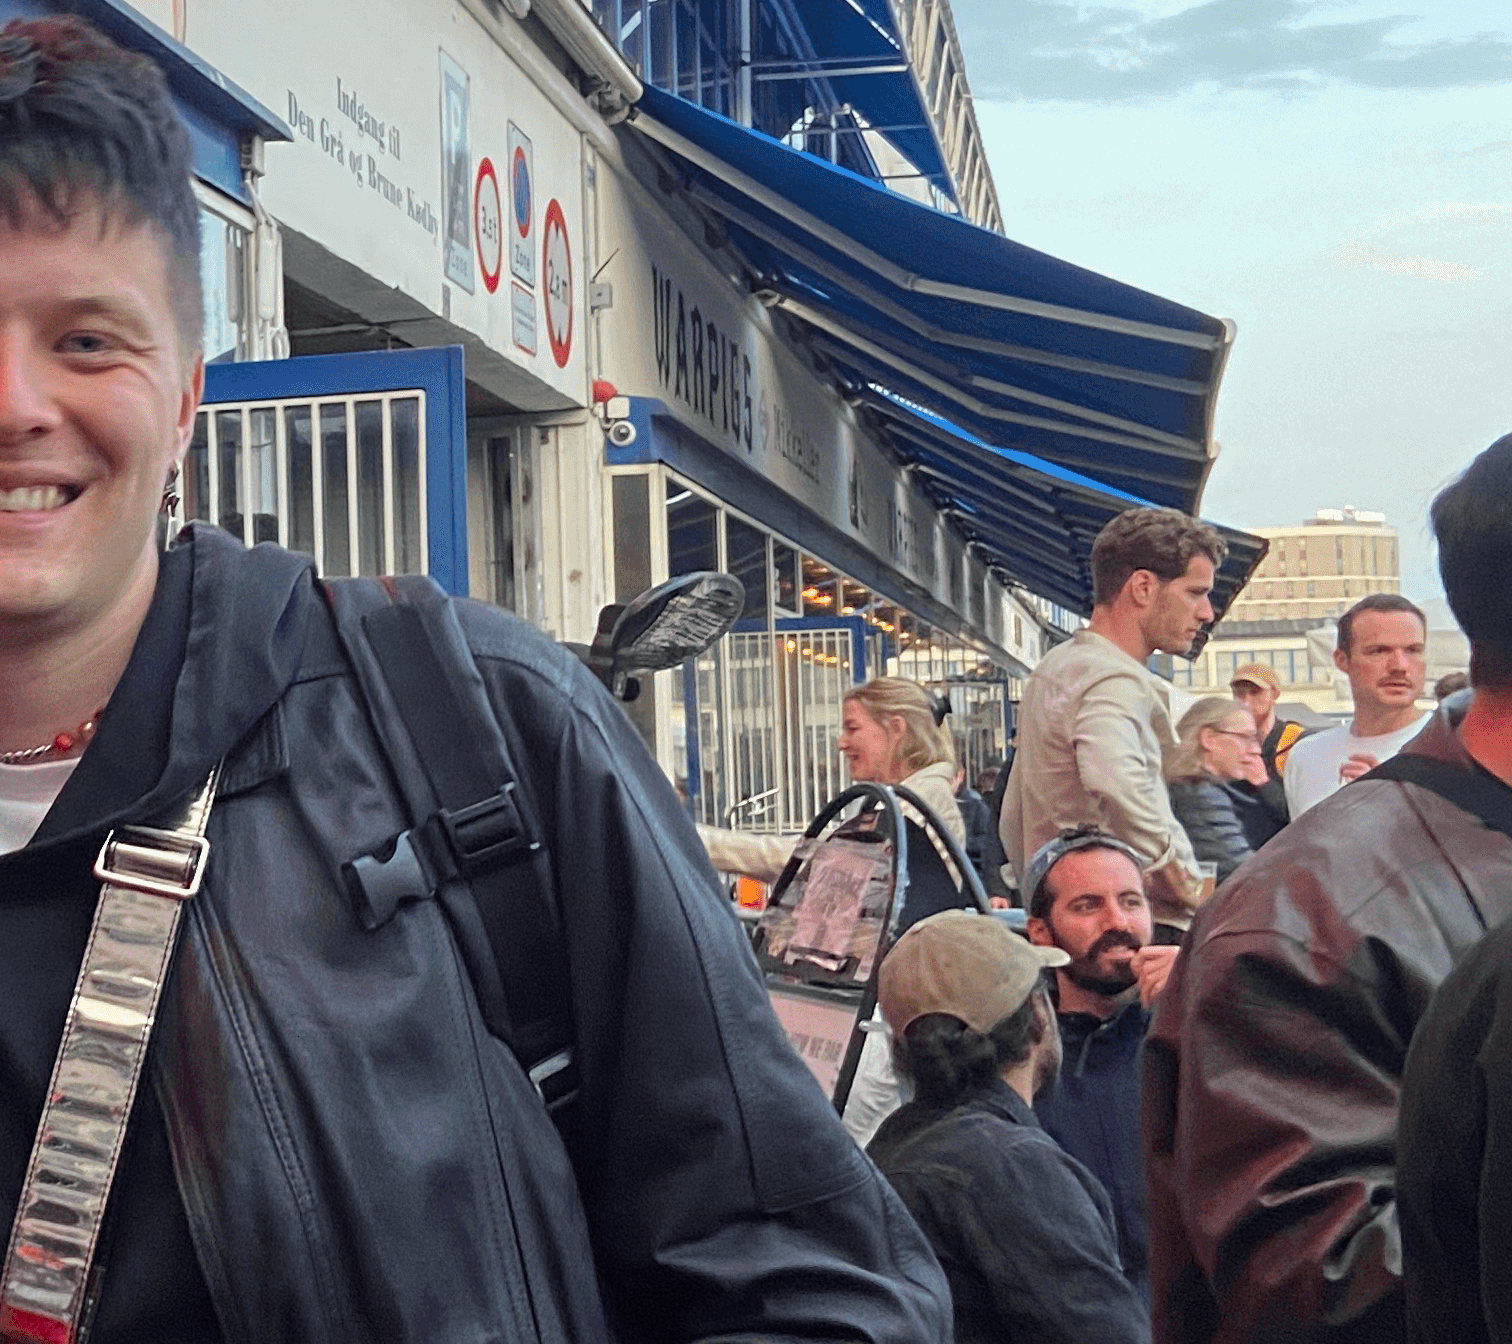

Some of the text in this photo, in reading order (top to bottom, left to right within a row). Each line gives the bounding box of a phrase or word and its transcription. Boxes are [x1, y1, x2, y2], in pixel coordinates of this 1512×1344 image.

[287, 88, 314, 143] Den
[349, 150, 364, 188] og
[367, 153, 402, 211] Brune
[336, 75, 400, 161] Indgang til
[651, 260, 753, 455] WARPIGS
